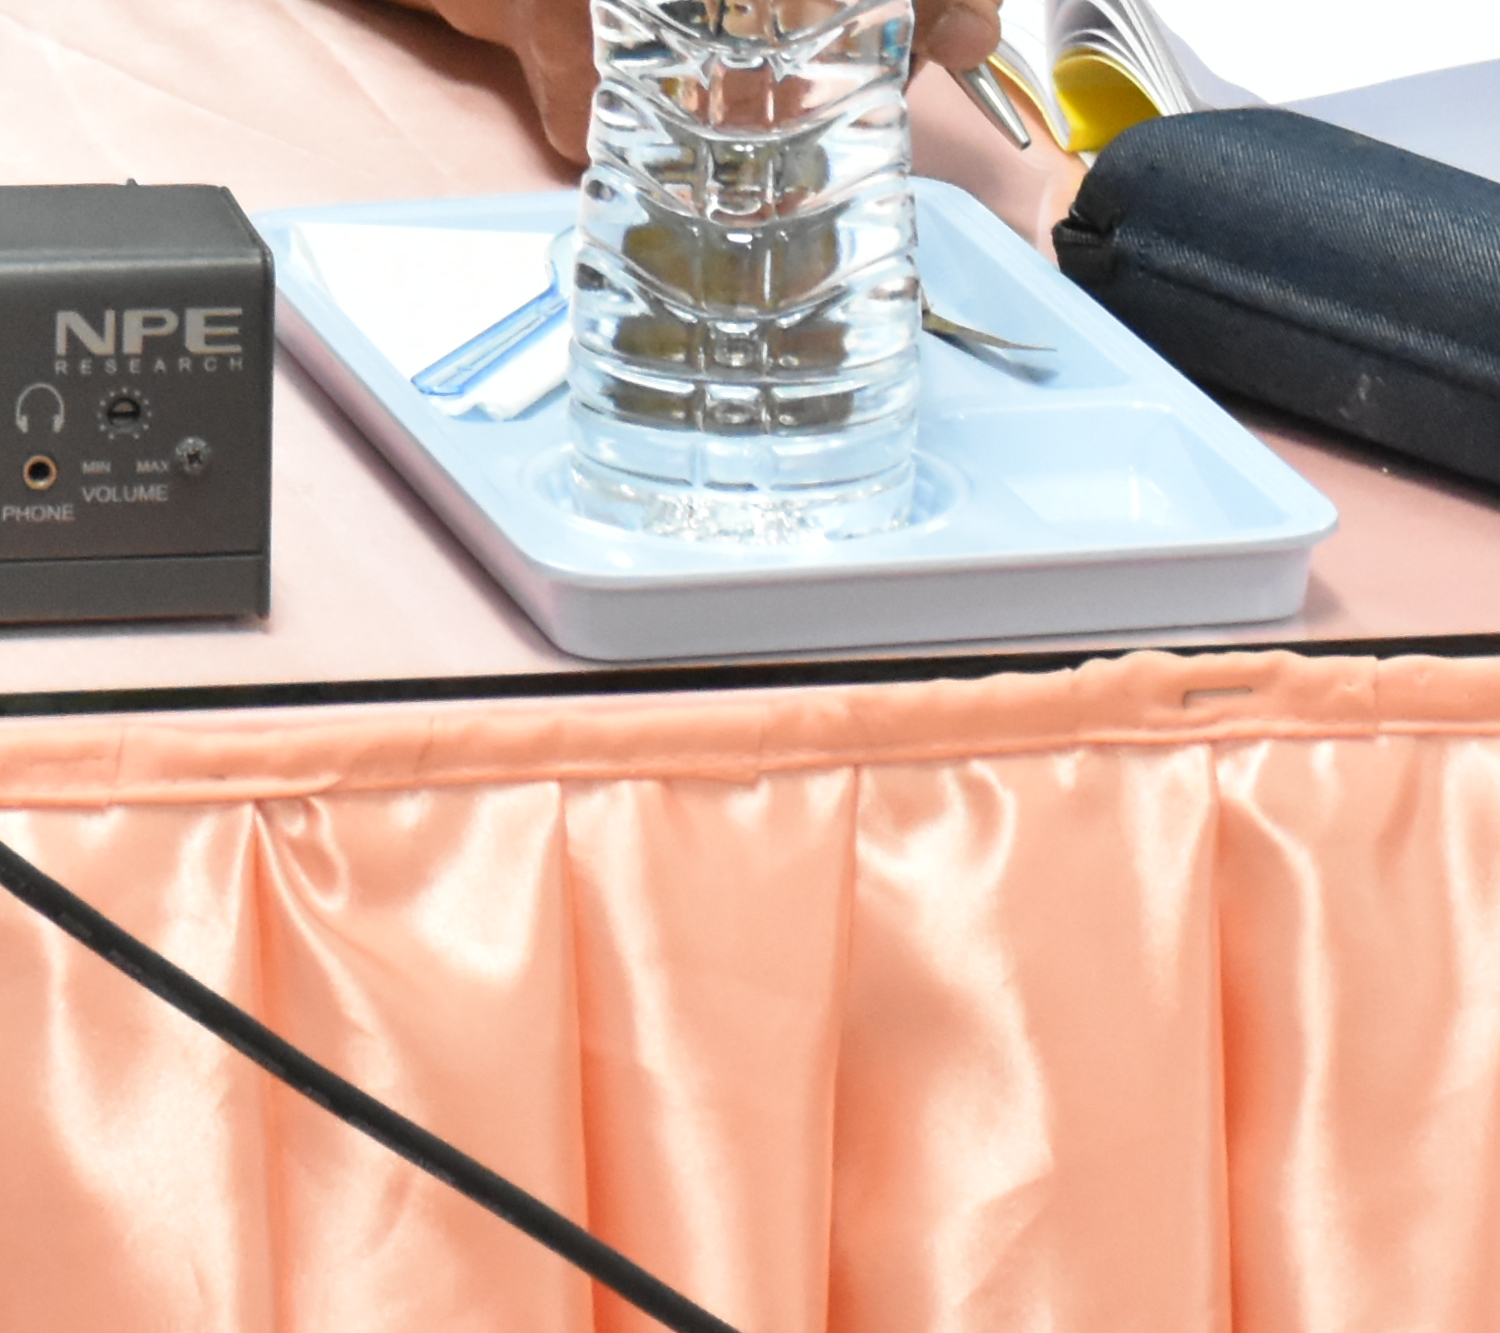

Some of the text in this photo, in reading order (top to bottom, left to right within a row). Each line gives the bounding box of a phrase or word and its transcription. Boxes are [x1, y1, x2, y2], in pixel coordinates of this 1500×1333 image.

[55, 306, 243, 357] NPE
[55, 357, 244, 375] RESEARCH
[81, 459, 112, 474] MIN
[136, 459, 170, 474] MAX
[81, 484, 169, 503] VOLUME
[1, 504, 76, 522] PHONE
